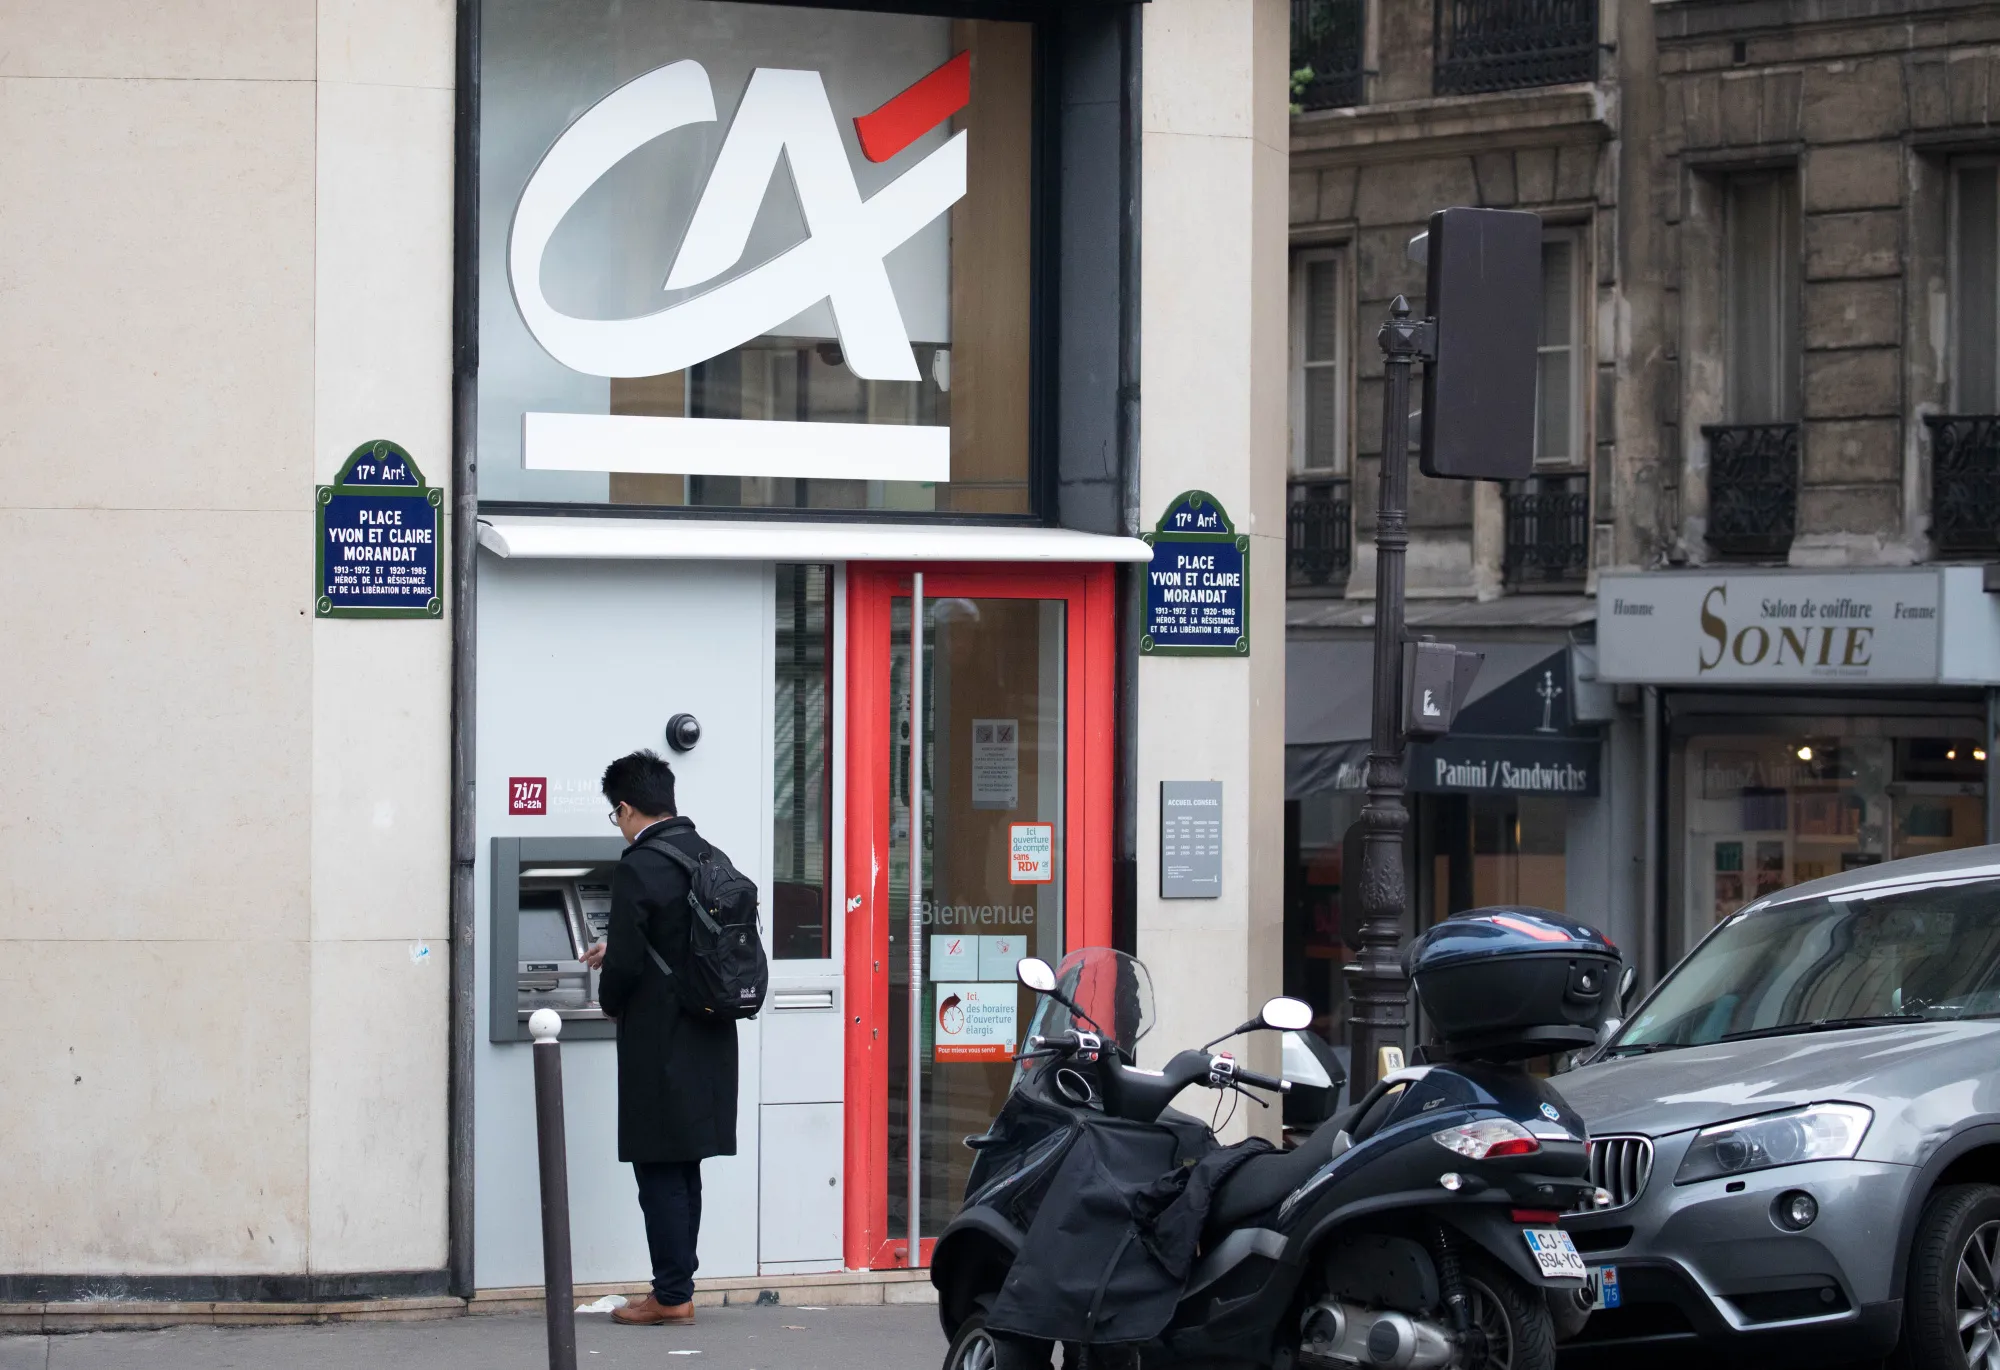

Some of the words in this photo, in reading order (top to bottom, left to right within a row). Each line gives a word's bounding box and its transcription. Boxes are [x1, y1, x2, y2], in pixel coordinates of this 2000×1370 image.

[360, 510, 402, 525] PLACE
[329, 528, 363, 543] YVON
[369, 529, 383, 542] ET
[389, 529, 432, 543] CLAIRE
[344, 546, 417, 561] MORANDAT
[1178, 556, 1214, 569] PLACE
[335, 576, 357, 584] HÉROS
[388, 576, 425, 584] RÉSISTANCE
[1151, 572, 1181, 586] YVON
[1186, 573, 1198, 586] ET
[1203, 573, 1240, 586] CLAIRE
[363, 585, 399, 594] LIBÉRATION
[1164, 590, 1226, 603] MORANDAT
[1614, 599, 1654, 616] Homme
[1761, 599, 1796, 619] Salon
[1801, 599, 1816, 619] de
[1820, 599, 1872, 620] coiffure
[1894, 602, 1935, 620] Femme
[1180, 625, 1211, 633] LIBÉRATION
[514, 782, 542, 800] 7j/7
[514, 801, 542, 809] 6h-22h
[1023, 844, 1049, 853] compte
[1018, 862, 1038, 871] RDV
[922, 902, 1033, 924] Bienvenue
[967, 1004, 980, 1013] des
[983, 1004, 1014, 1013] horaires
[967, 1015, 1011, 1023] d'ouverture
[966, 1025, 993, 1036] élargis
[1538, 1252, 1582, 1268] 694-YC
[1605, 1289, 1617, 1301] 75
